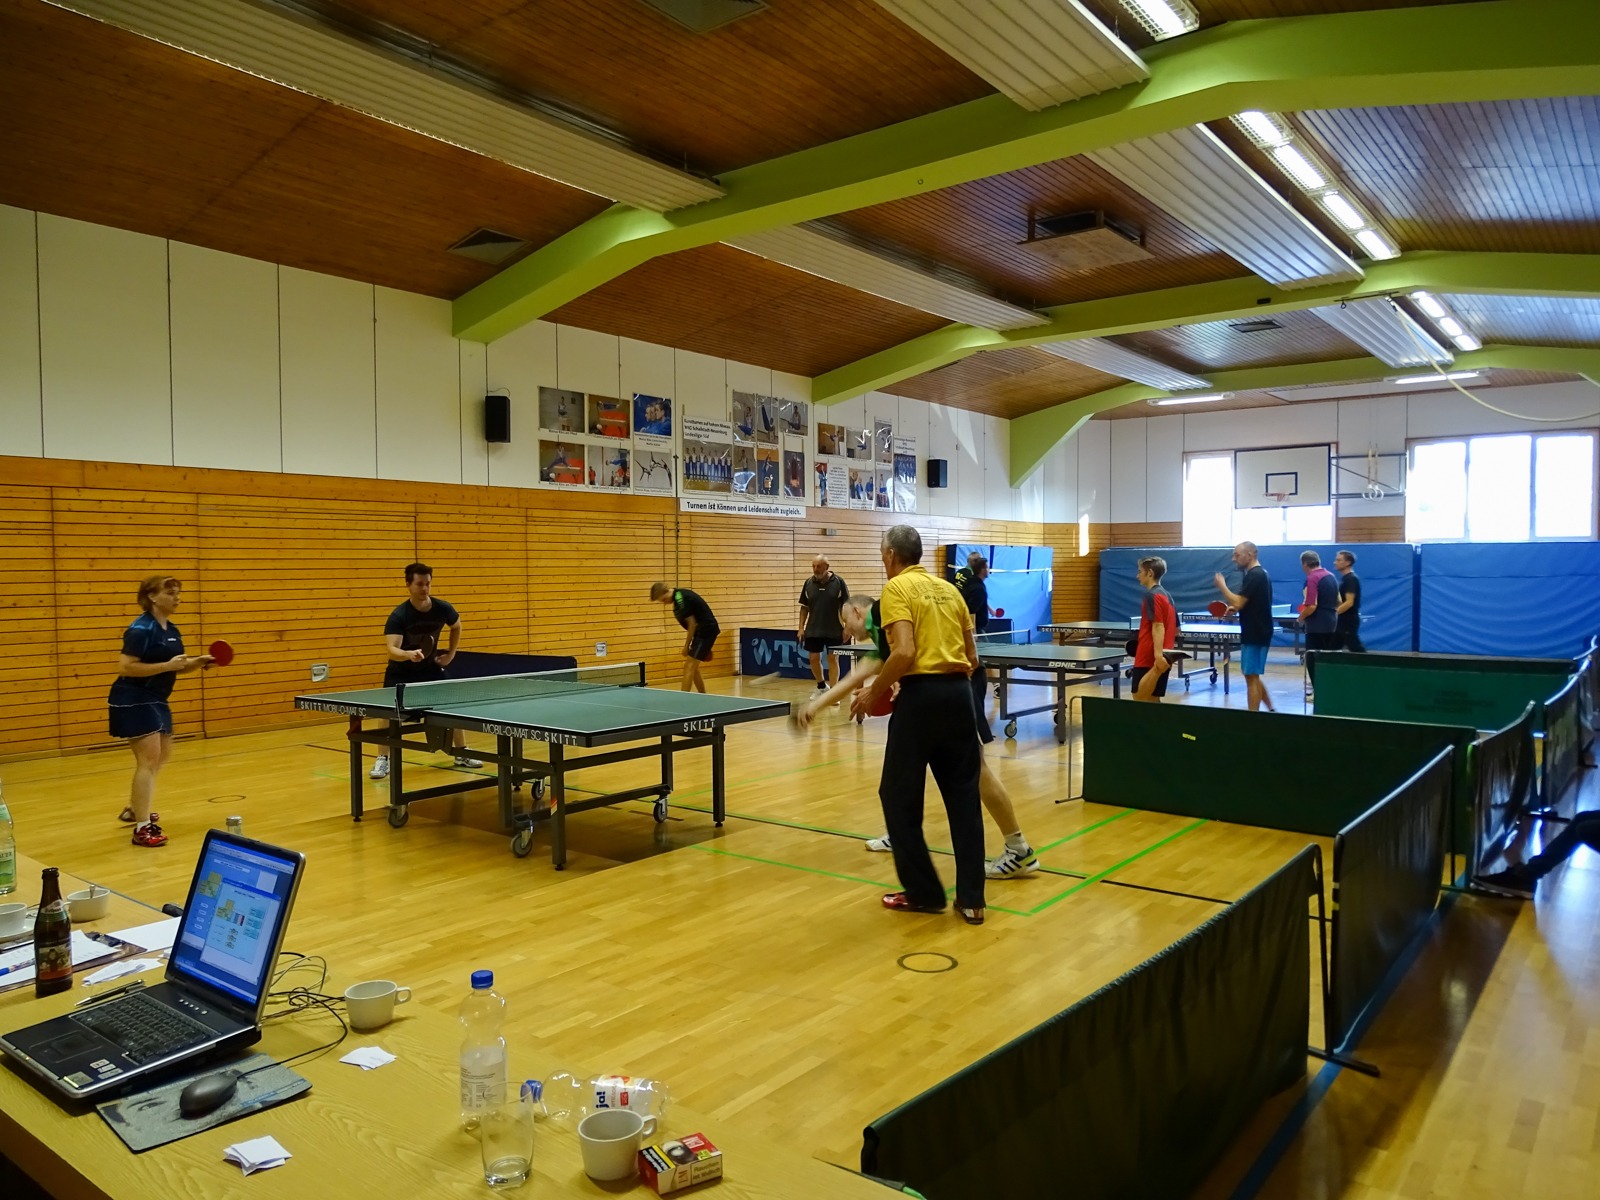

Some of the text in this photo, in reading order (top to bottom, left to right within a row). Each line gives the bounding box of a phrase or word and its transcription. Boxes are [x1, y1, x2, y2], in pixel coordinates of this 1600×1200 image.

[717, 503, 736, 511] Können
[780, 508, 801, 516] zugleich.
[300, 701, 367, 717] SKITT MOBIL-O-MAT SC
[683, 718, 715, 733] SKITT
[482, 723, 577, 746] MOBIL-O-MAT SC SKITT
[595, 1091, 609, 1108] ja!
